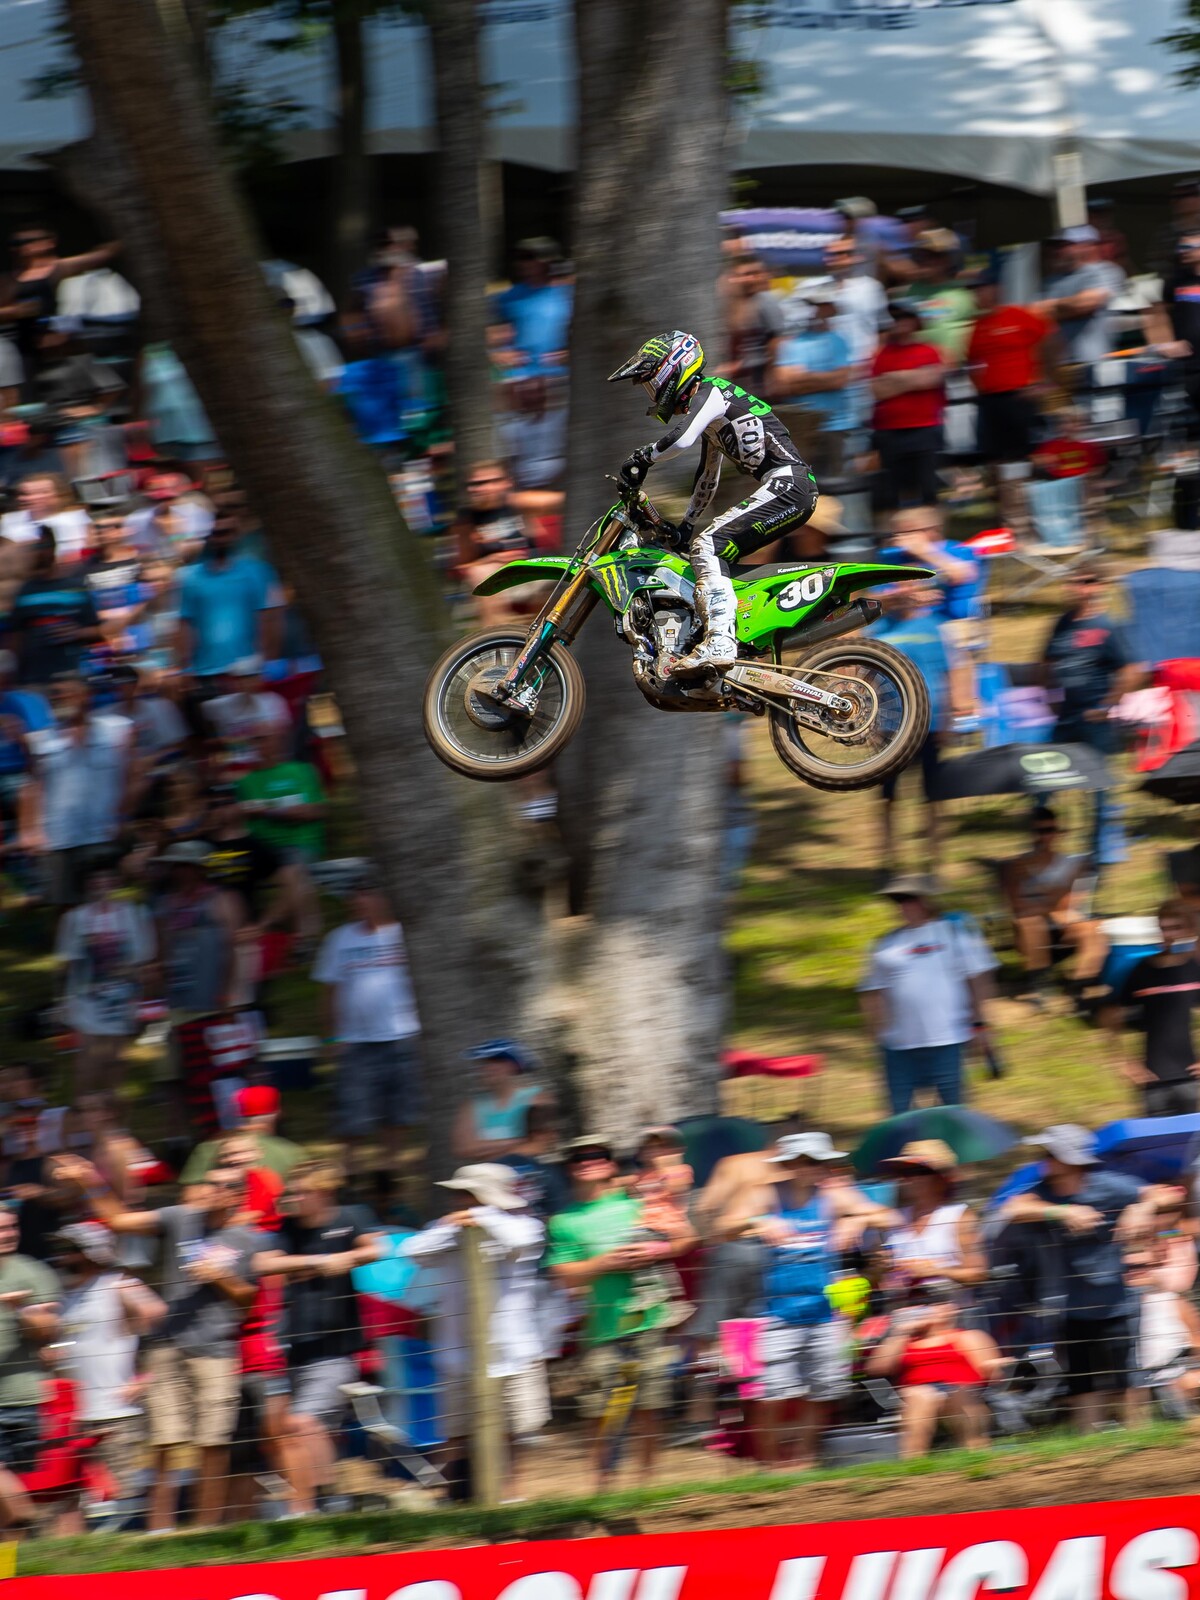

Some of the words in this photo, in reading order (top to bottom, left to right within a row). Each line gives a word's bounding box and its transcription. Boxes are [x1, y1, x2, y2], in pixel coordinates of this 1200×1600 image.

[737, 416, 763, 460] FOX
[763, 504, 798, 527] MONSTER
[777, 564, 808, 574] Kawasaki
[780, 573, 824, 609] 30
